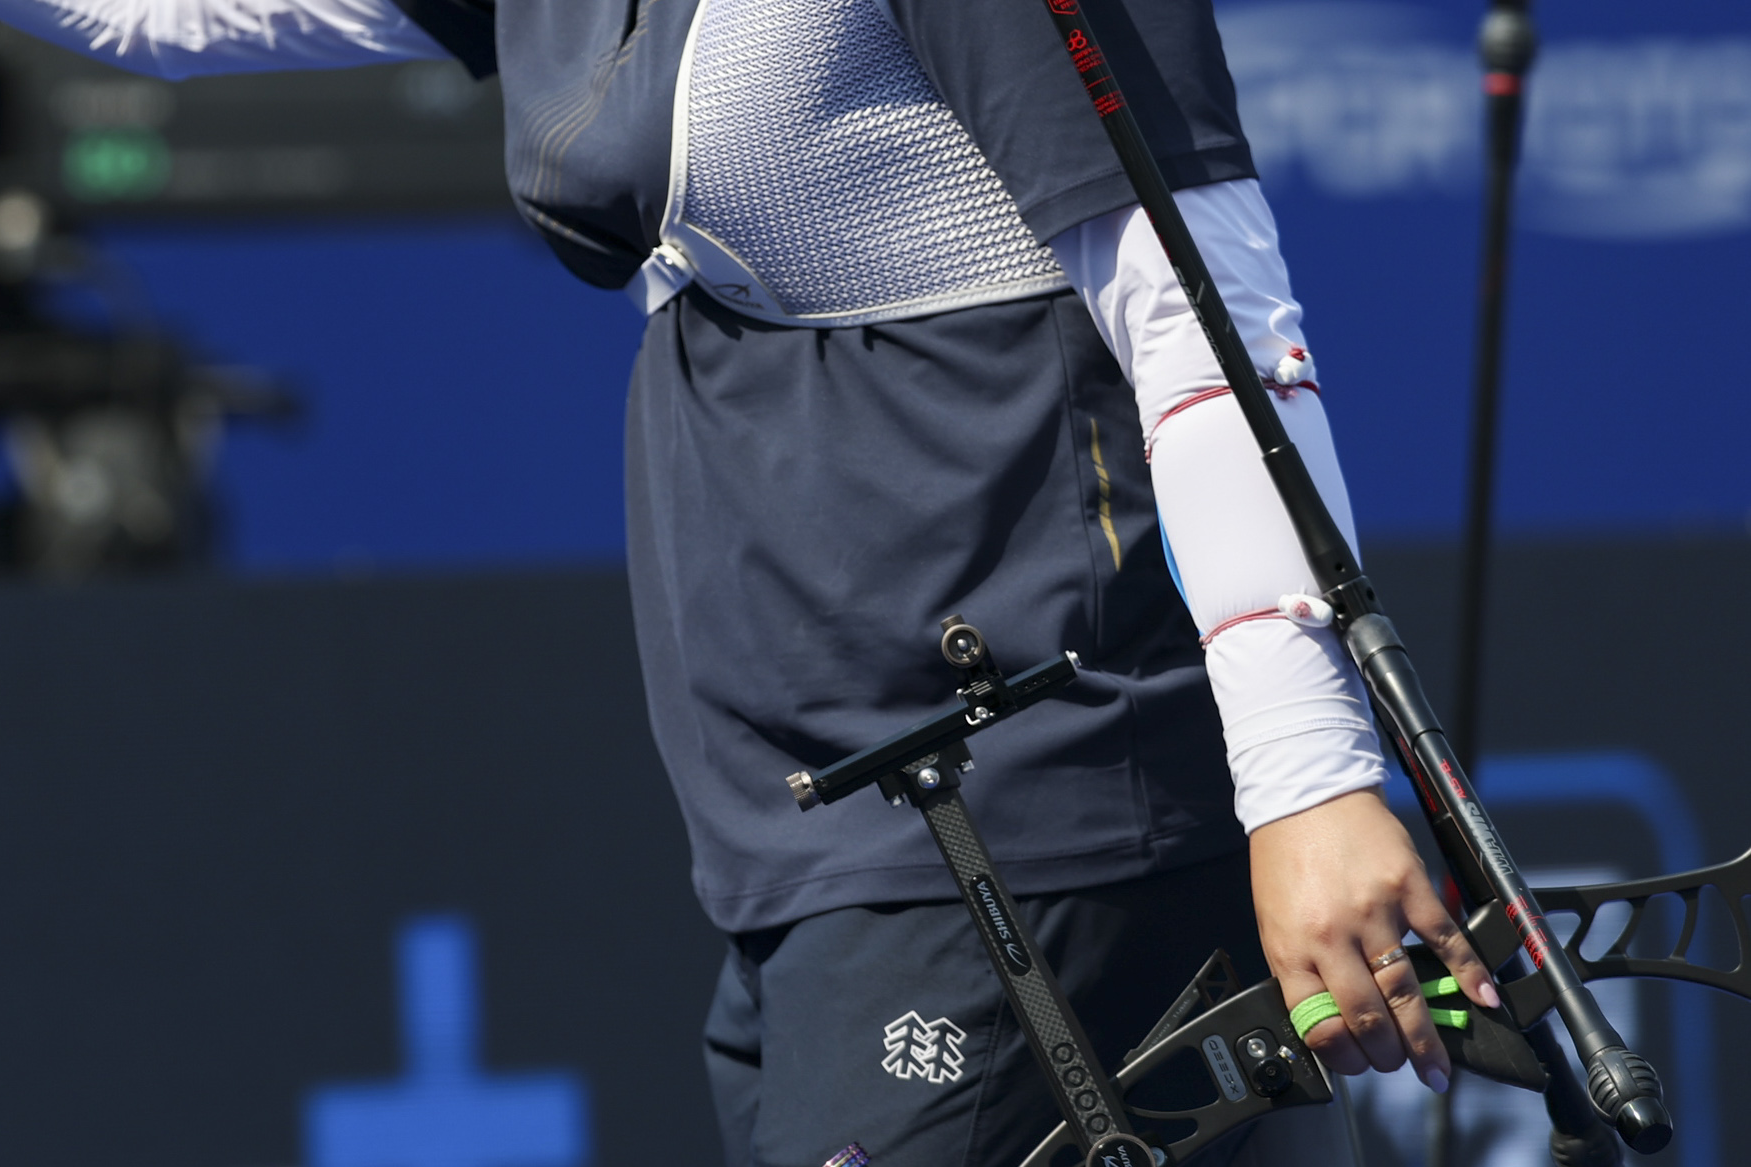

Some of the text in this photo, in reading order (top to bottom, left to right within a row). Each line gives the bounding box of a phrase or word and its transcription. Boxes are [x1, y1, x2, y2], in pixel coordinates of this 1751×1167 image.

[1459, 800, 1514, 877] WIAWIS
[976, 880, 1013, 940] SHIBUYA
[1208, 1039, 1240, 1094] XCEED
